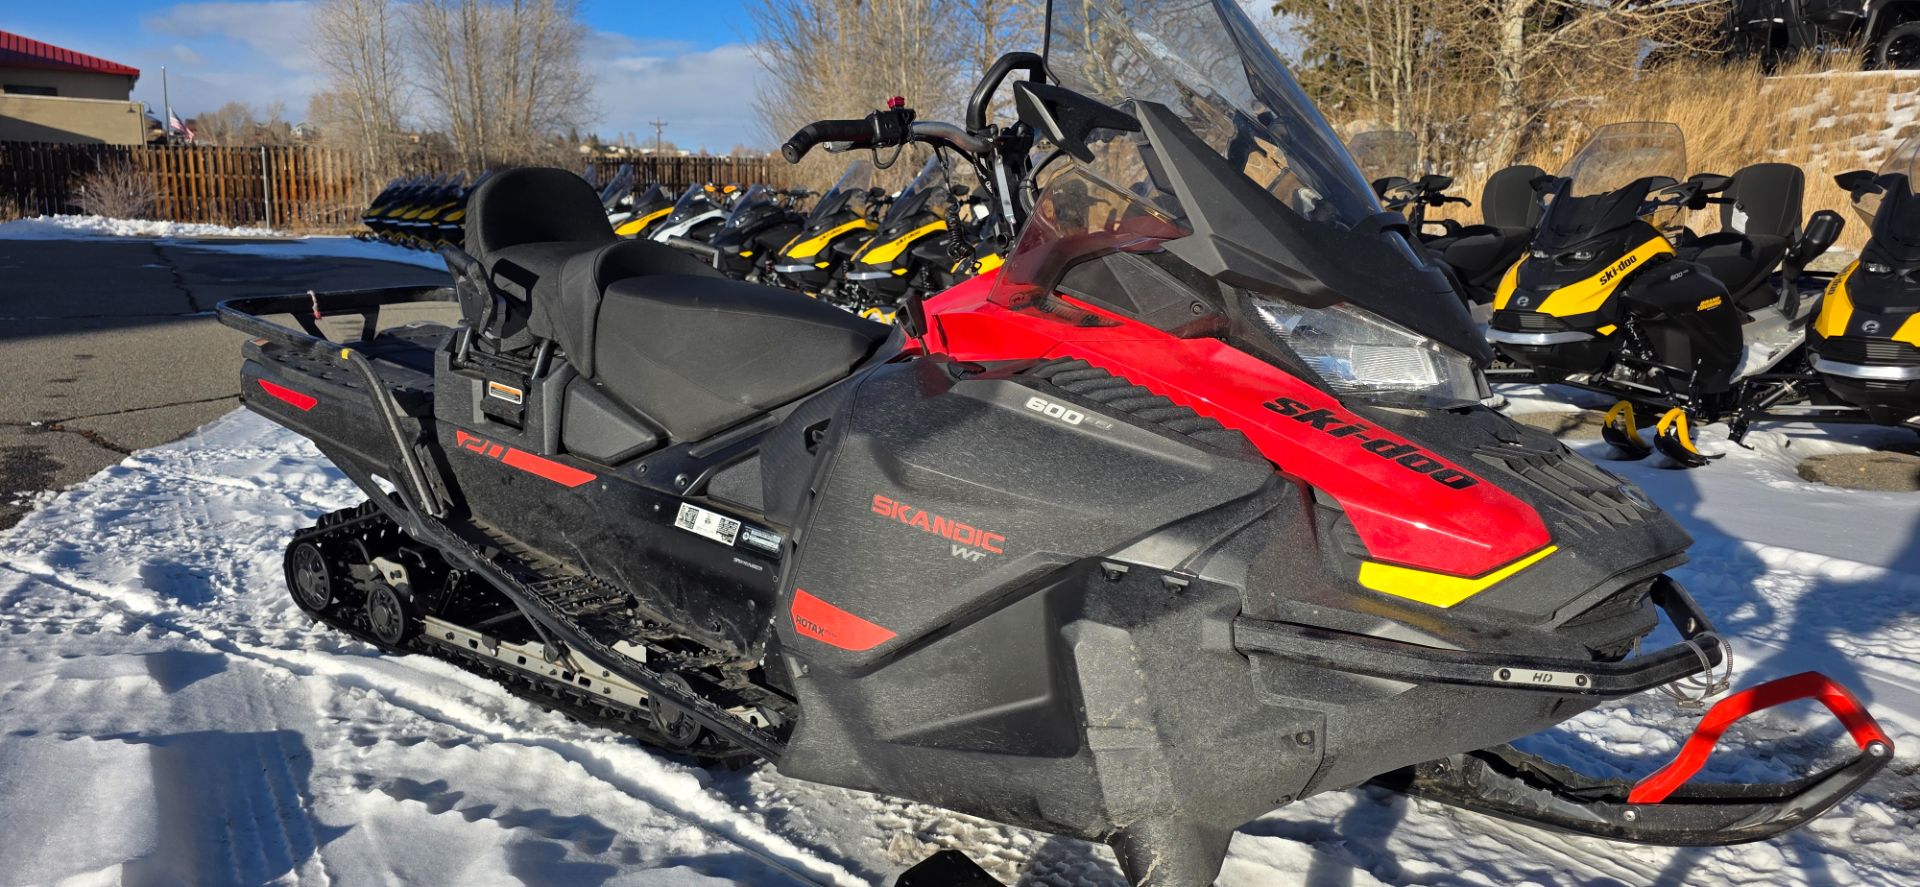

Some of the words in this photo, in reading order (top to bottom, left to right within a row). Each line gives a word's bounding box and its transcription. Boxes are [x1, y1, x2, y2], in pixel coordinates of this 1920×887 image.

[1599, 255, 1637, 286] ski-doo
[1025, 396, 1085, 425] 600
[1262, 396, 1480, 491] ski-doo
[871, 493, 1007, 555] SKANDIC
[951, 543, 987, 562] WT
[795, 614, 825, 637] ROTAX
[1531, 672, 1554, 683] HD
